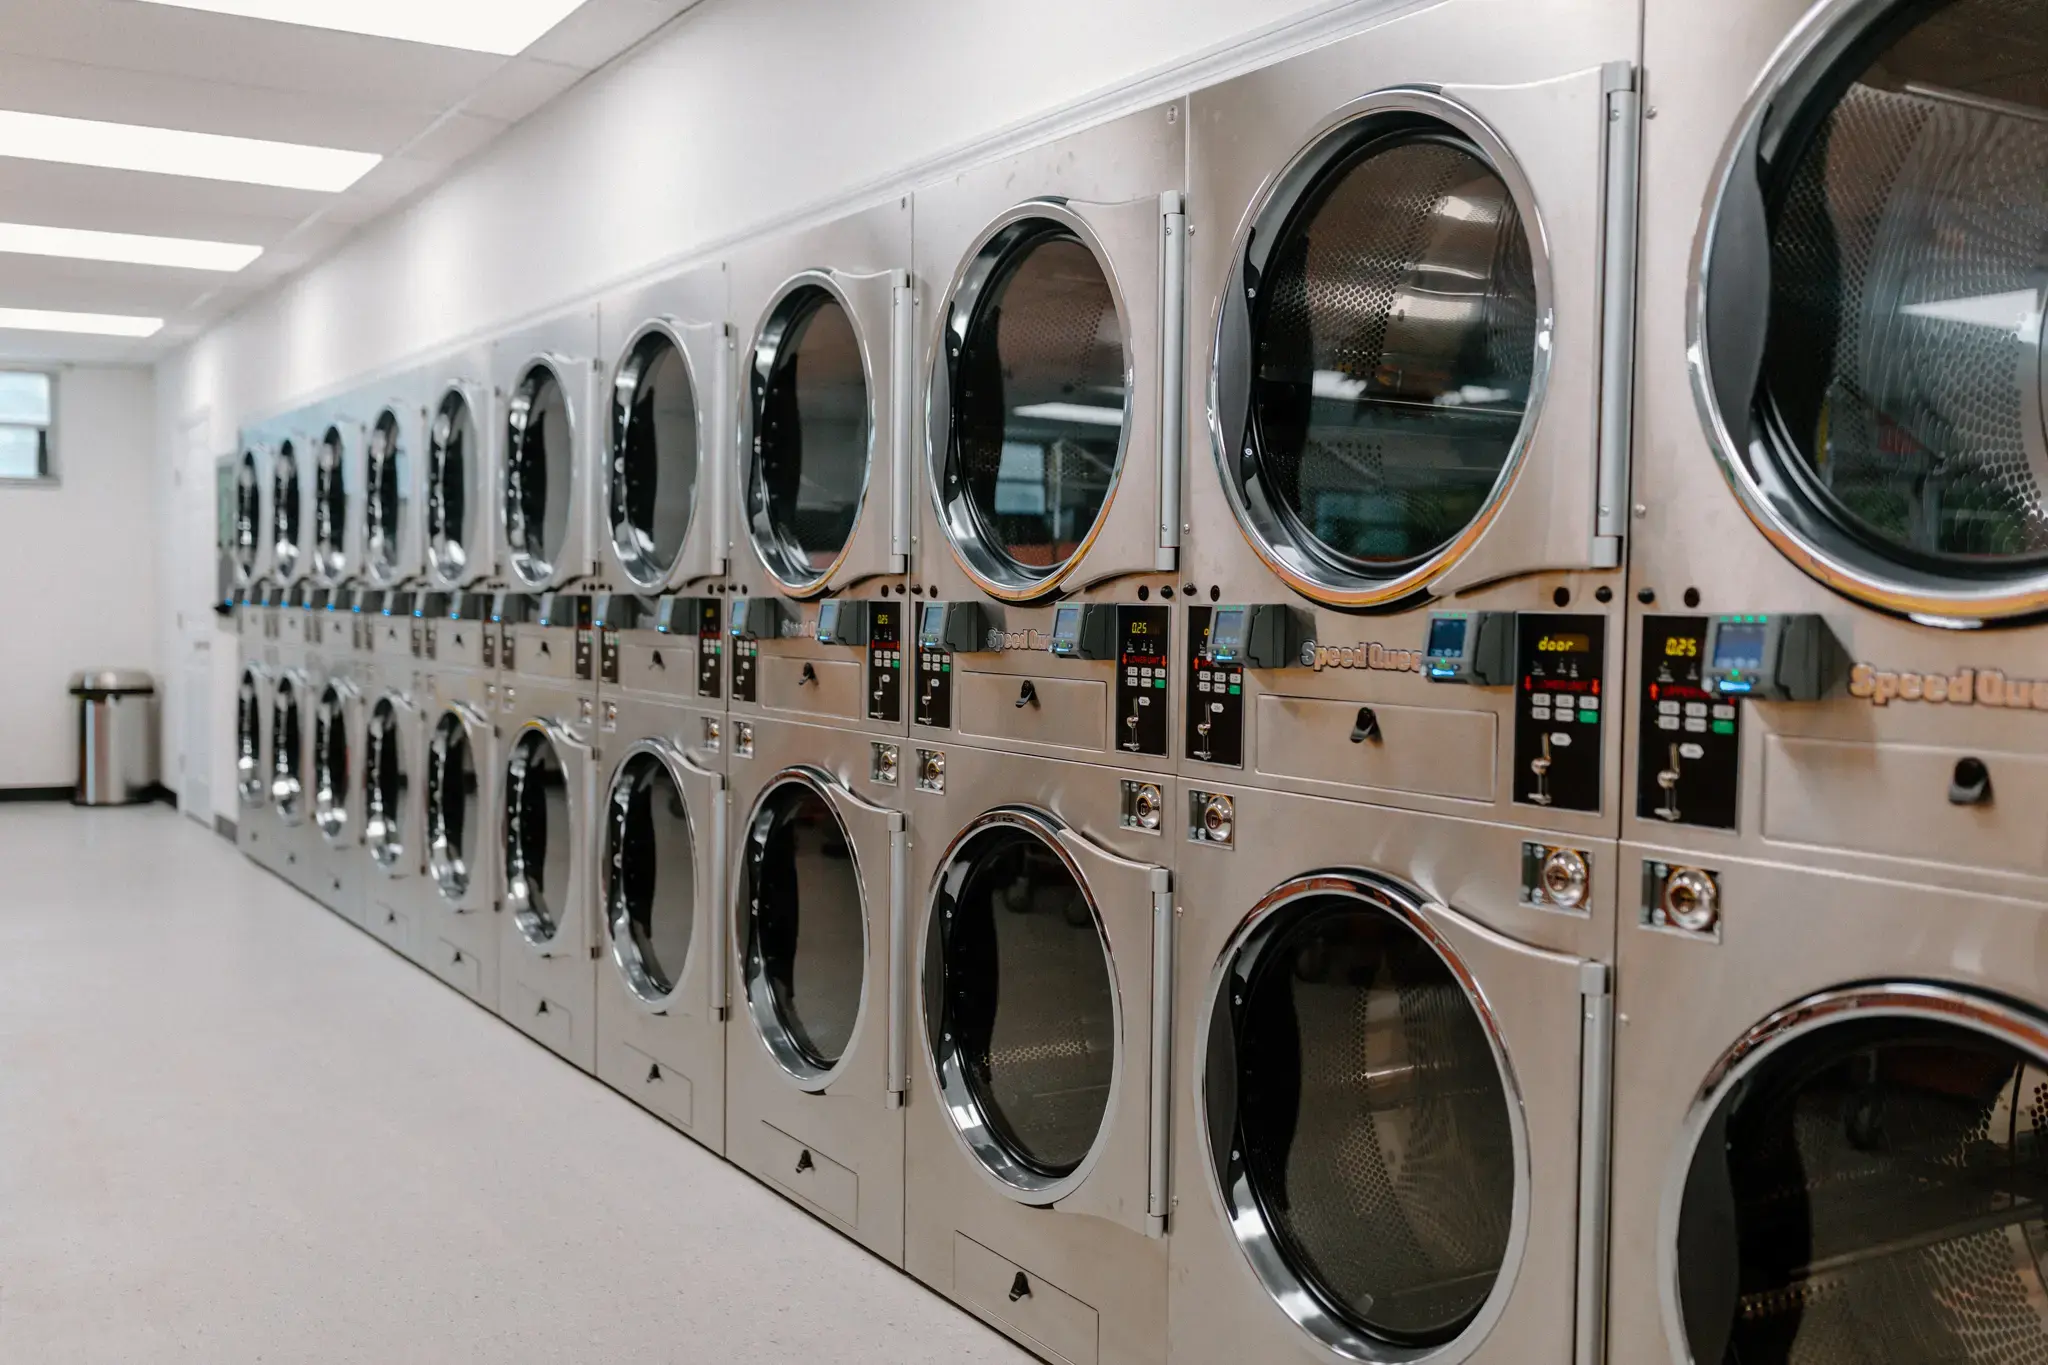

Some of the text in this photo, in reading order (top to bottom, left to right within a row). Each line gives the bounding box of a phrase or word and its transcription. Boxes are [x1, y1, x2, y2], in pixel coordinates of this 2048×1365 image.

[987, 627, 1028, 653] Speed
[1538, 635, 1573, 652] door
[1301, 640, 1367, 672] Speed
[1849, 662, 1975, 706] Speed
